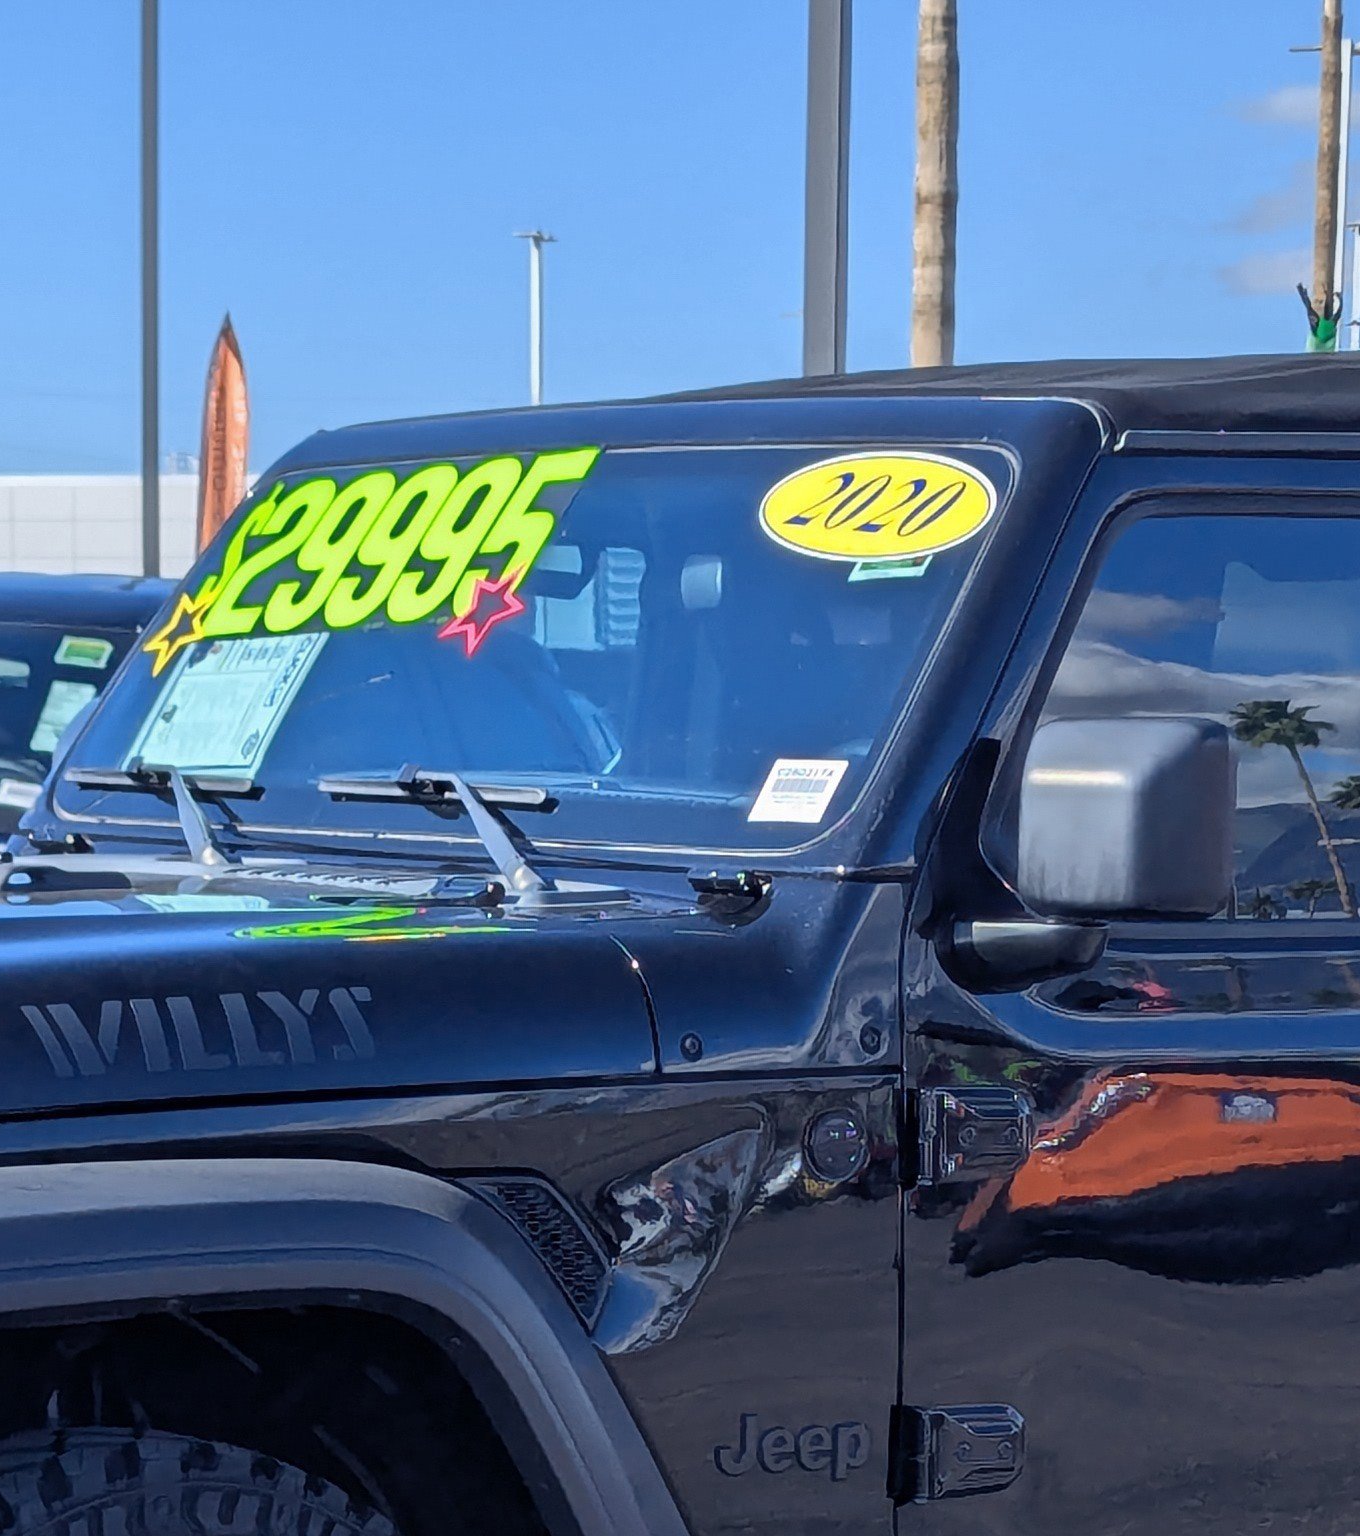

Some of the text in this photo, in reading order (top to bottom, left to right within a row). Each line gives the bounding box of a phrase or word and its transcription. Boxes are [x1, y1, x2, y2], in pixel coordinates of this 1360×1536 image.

[198, 447, 600, 636] $29995
[782, 471, 967, 537] 2020
[20, 986, 377, 1079] WILLYS
[713, 1412, 873, 1481] Jeep
